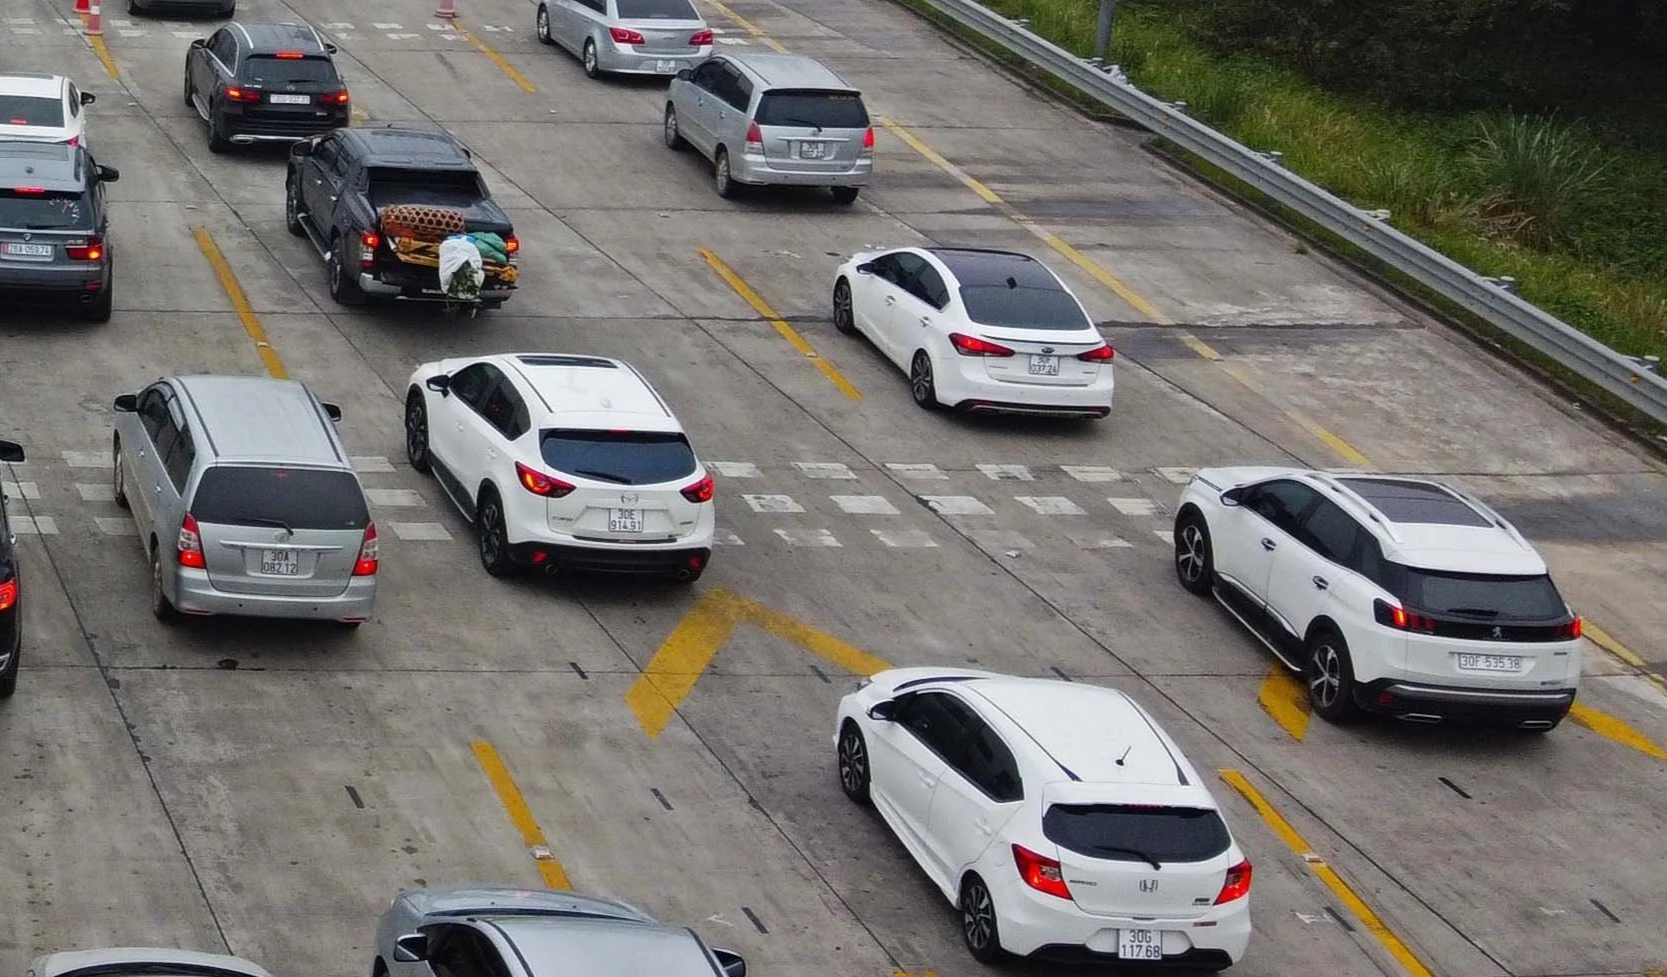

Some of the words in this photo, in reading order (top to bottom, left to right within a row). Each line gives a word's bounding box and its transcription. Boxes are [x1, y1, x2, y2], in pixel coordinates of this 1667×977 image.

[618, 509, 636, 520] 30E
[271, 551, 289, 561] 30A
[1129, 930, 1152, 944] 30G
